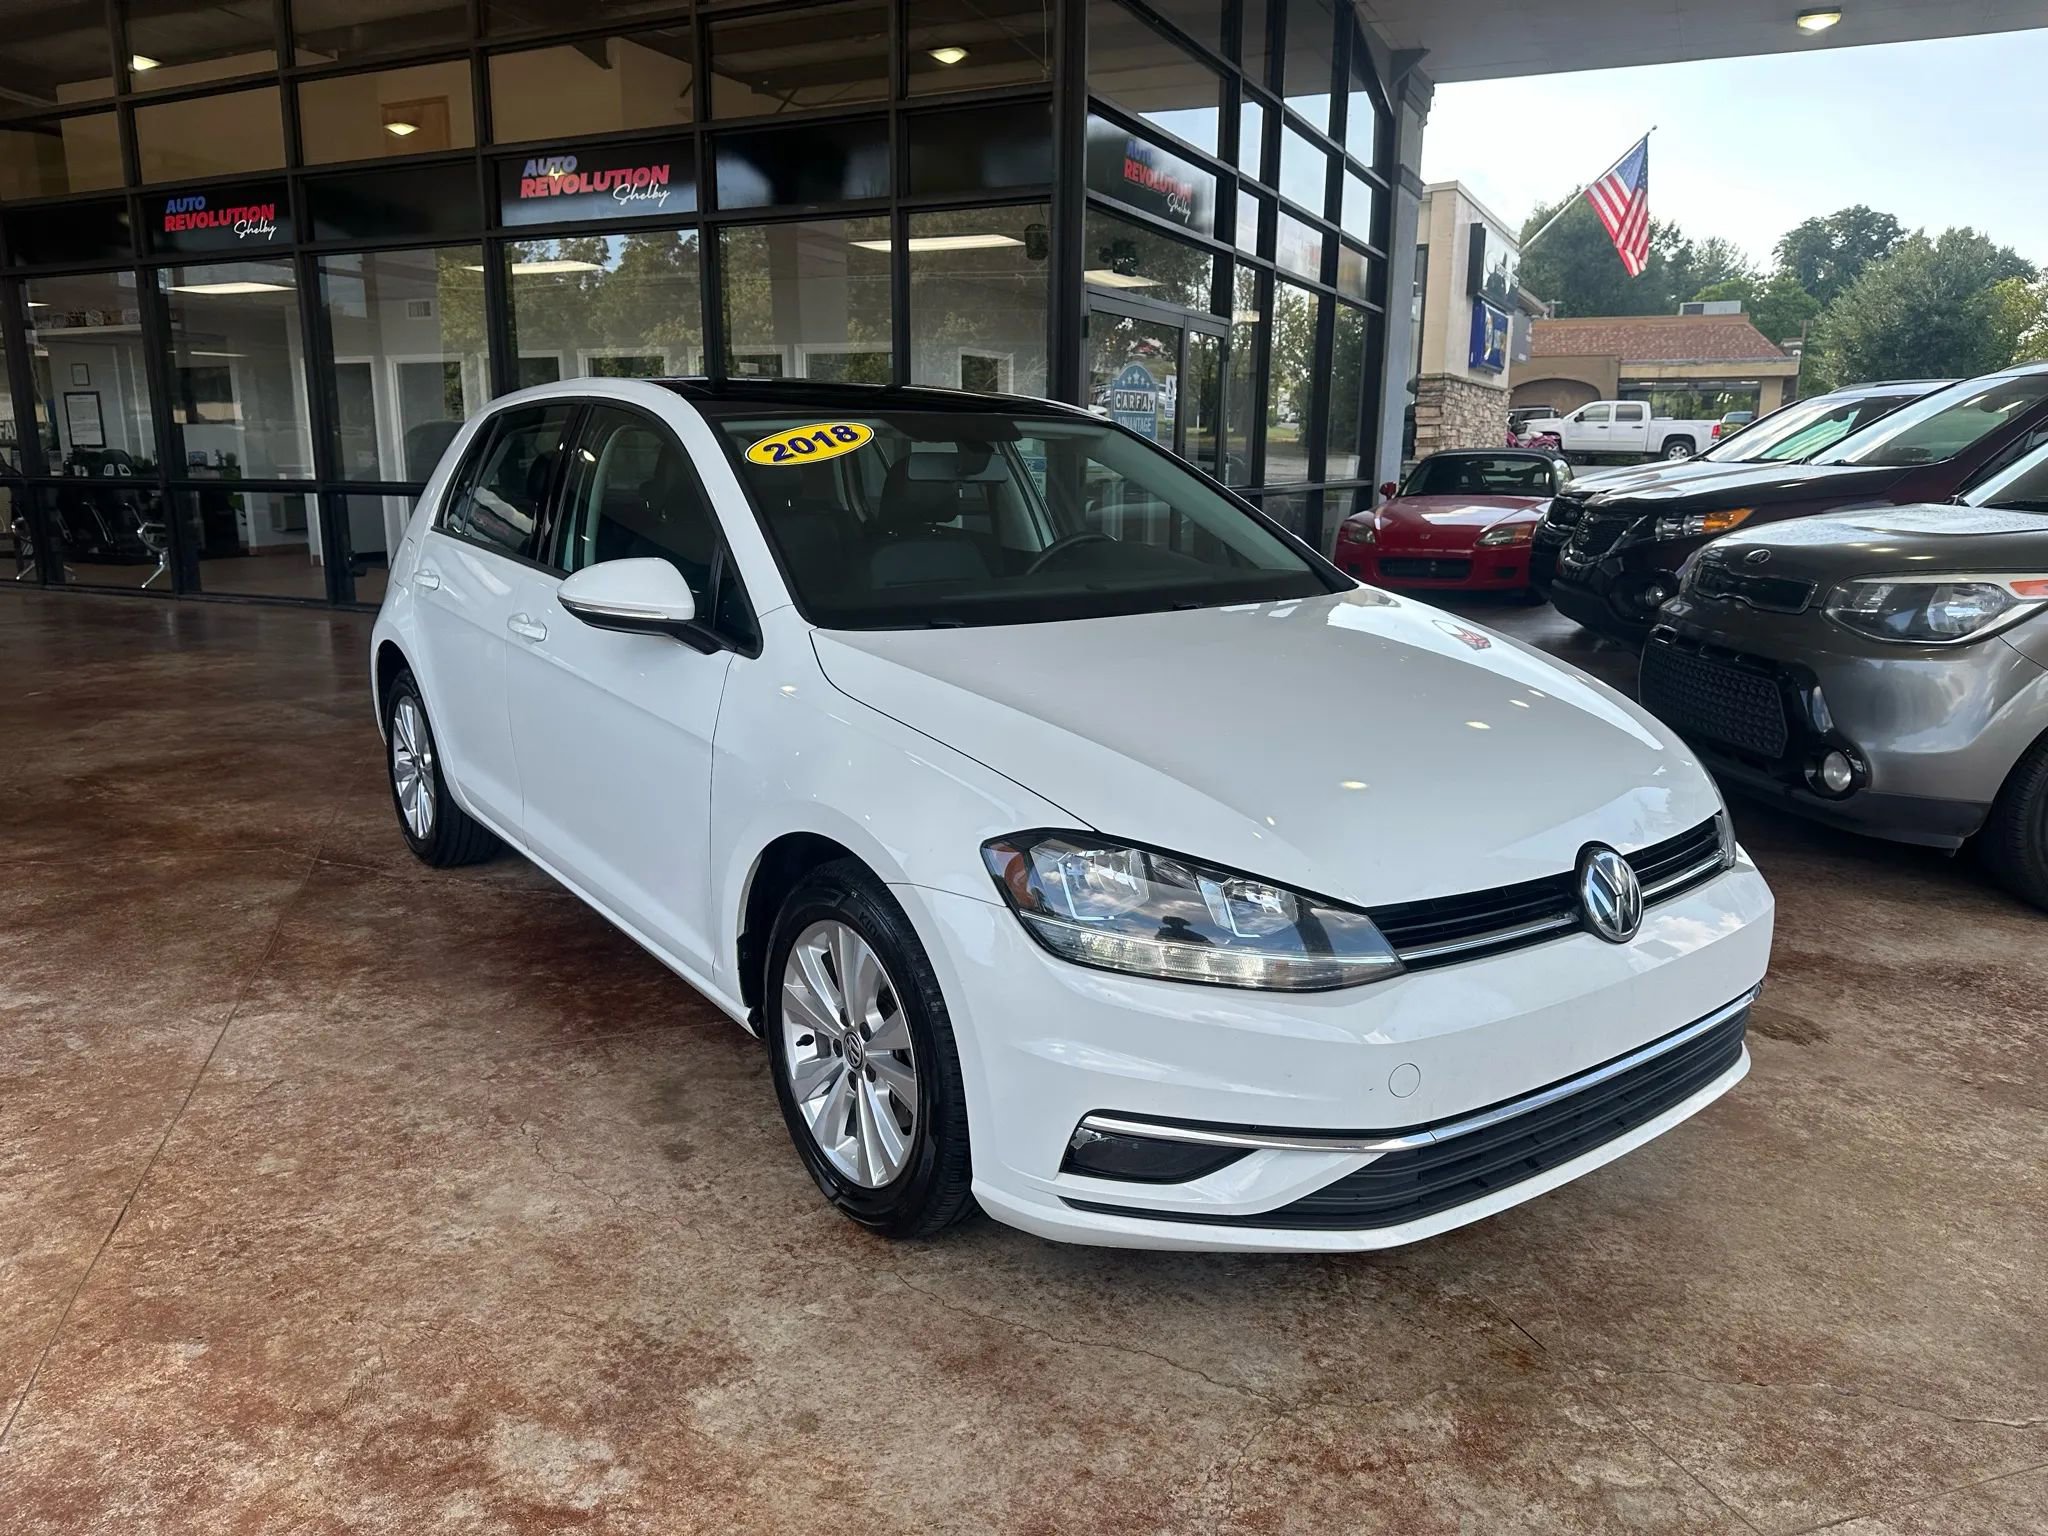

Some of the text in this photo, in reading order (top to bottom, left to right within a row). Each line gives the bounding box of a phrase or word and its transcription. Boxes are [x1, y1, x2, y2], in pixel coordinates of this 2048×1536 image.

[522, 155, 578, 177] AUTO
[520, 164, 670, 199] REVOLUTION
[613, 179, 671, 208] Shelby
[1124, 158, 1192, 205] REVOLUTION
[165, 203, 275, 232] REVOLUTION
[166, 195, 206, 214] AUTO
[1167, 192, 1192, 224] Shelby
[234, 216, 277, 240] Shelby
[1115, 392, 1155, 413] CARFAX
[763, 425, 860, 462] 2018
